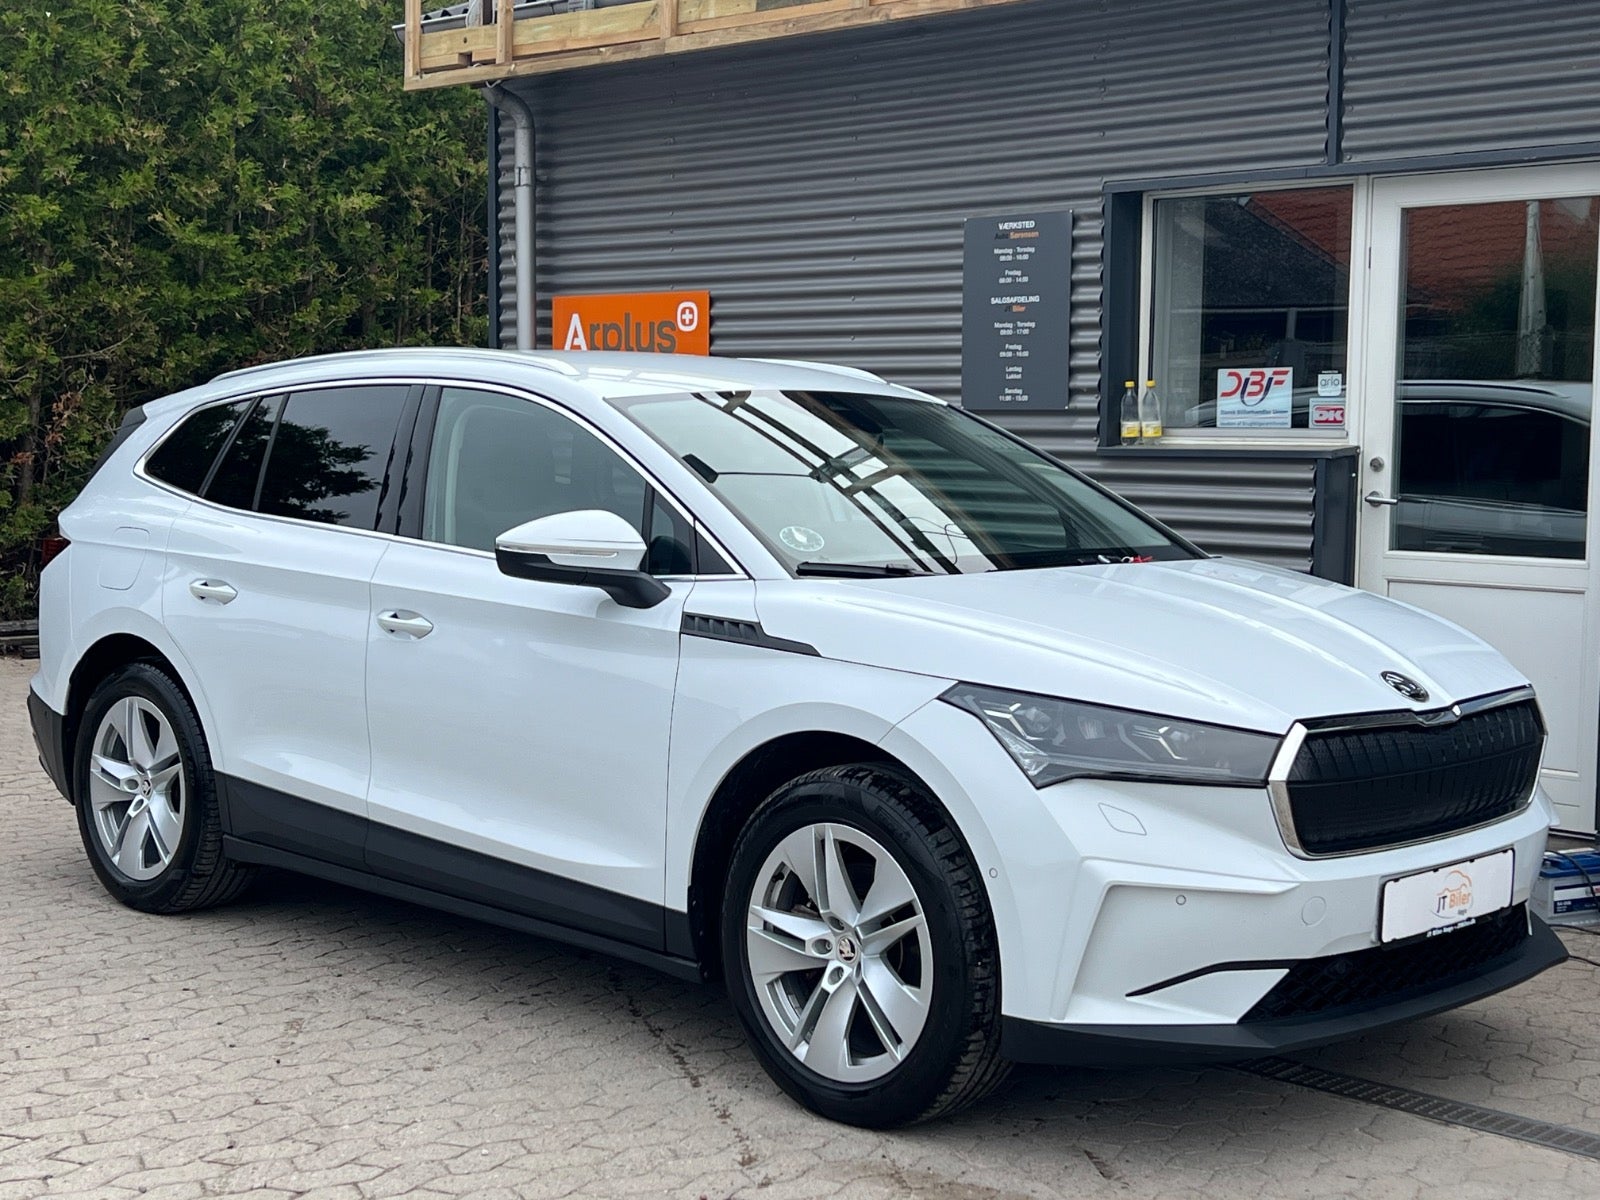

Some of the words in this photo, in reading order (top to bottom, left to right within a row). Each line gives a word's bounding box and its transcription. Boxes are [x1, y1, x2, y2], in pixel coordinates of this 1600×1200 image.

[998, 220, 1035, 230] VÆRKSTED
[990, 295, 1040, 304] SALGSAFDELING
[1449, 891, 1471, 909] Biler
